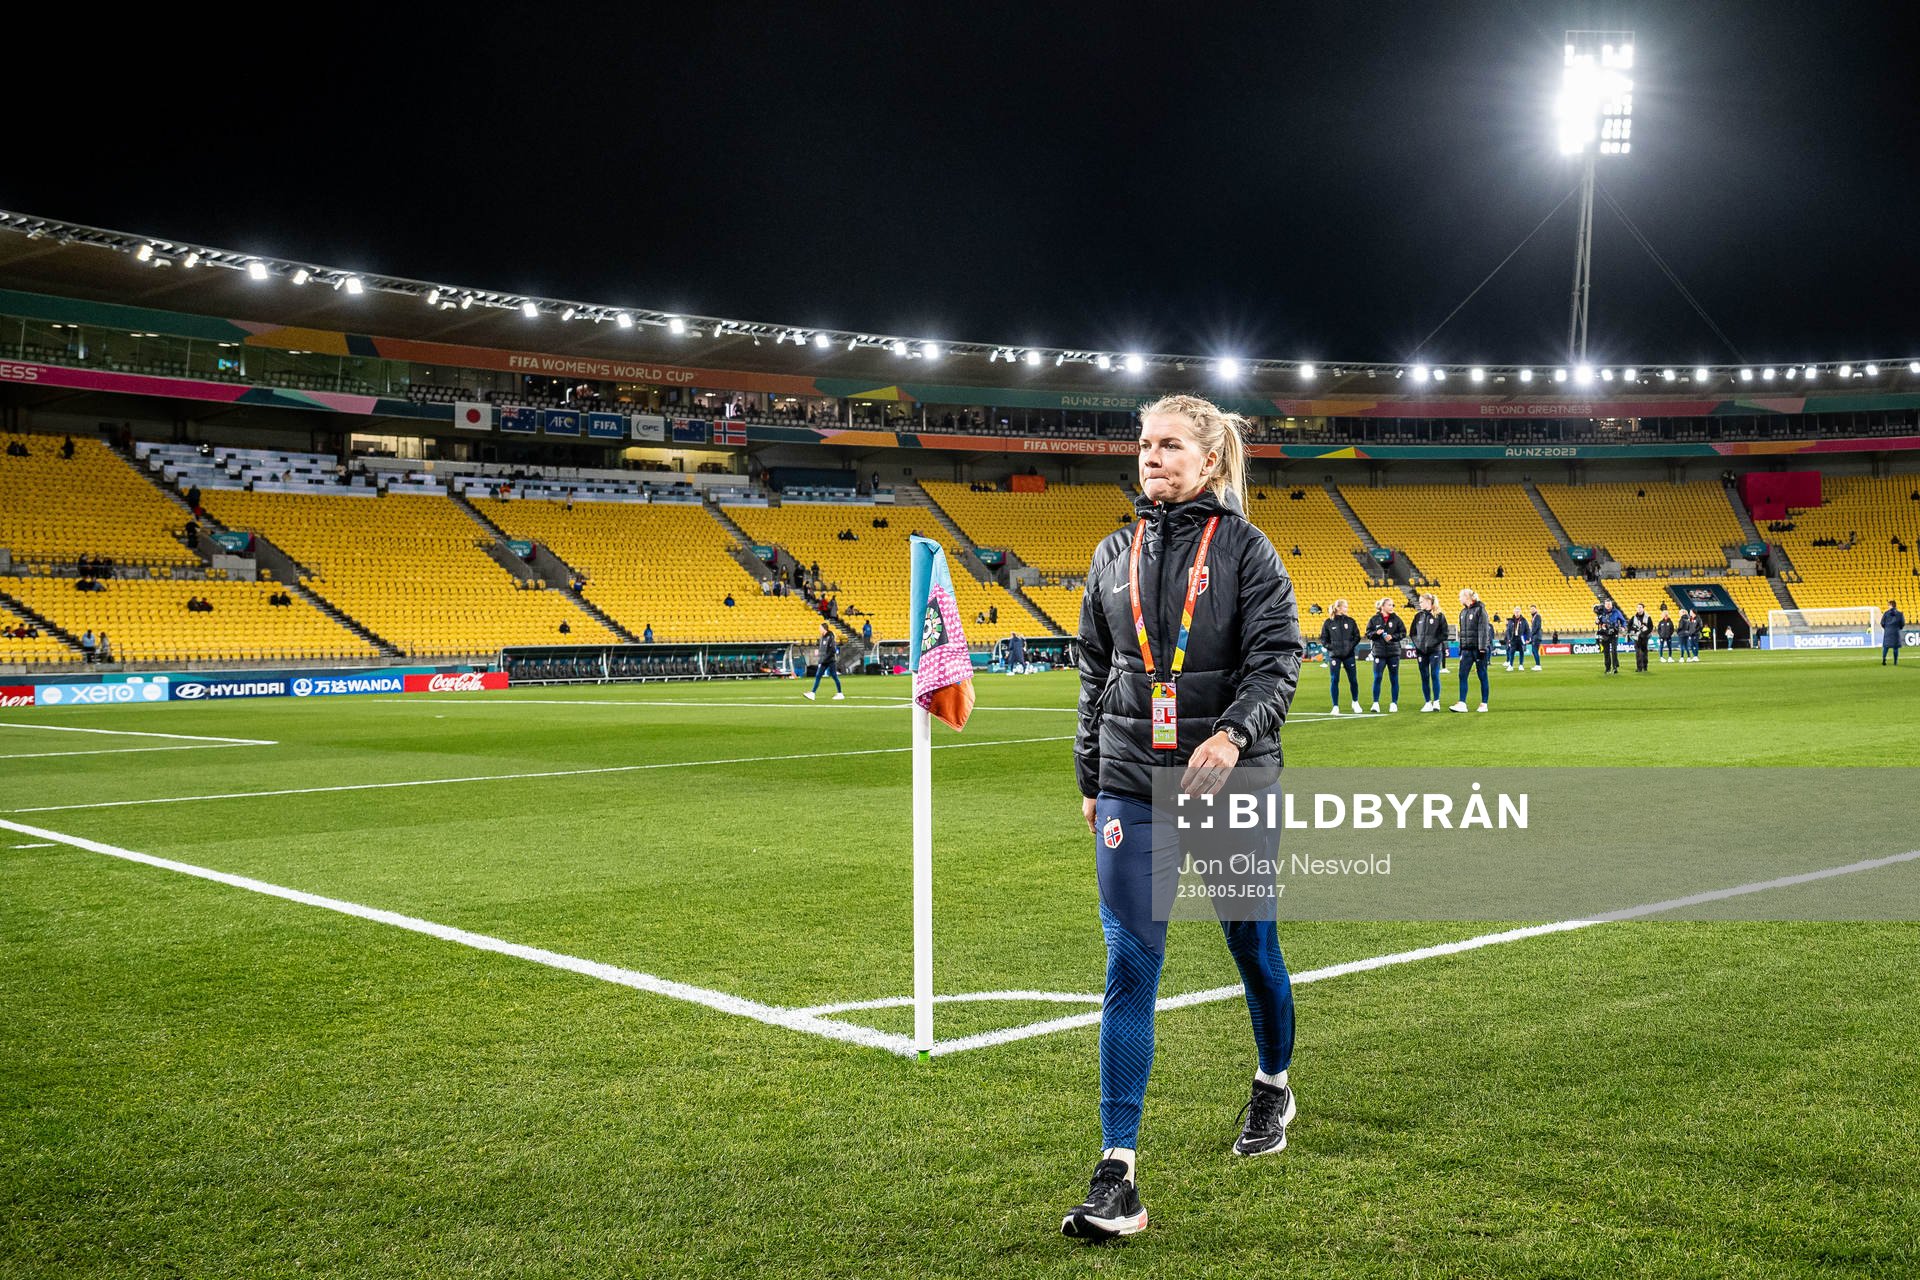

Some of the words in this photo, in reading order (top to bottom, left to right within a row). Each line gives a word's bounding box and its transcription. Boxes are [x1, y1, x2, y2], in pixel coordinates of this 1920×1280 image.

[509, 355, 539, 369] FIFA
[541, 358, 610, 375] WOMEN'S
[613, 366, 662, 381] WORLD
[666, 370, 695, 383] CUP
[1480, 404, 1525, 415] BEYOND
[1527, 404, 1593, 415] GREATNESS
[593, 420, 618, 431] FIFA
[1023, 440, 1048, 451] FIFA
[1050, 442, 1106, 452] WOMEN'S
[1108, 443, 1140, 454] WORL
[1794, 634, 1865, 648] Booking.com
[1905, 632, 1920, 646] Gl
[315, 680, 347, 694] 万达
[347, 679, 402, 692] WANDA
[428, 672, 486, 691] Coca-Cola
[71, 685, 134, 702] xero
[210, 682, 285, 696] HYUNDAI
